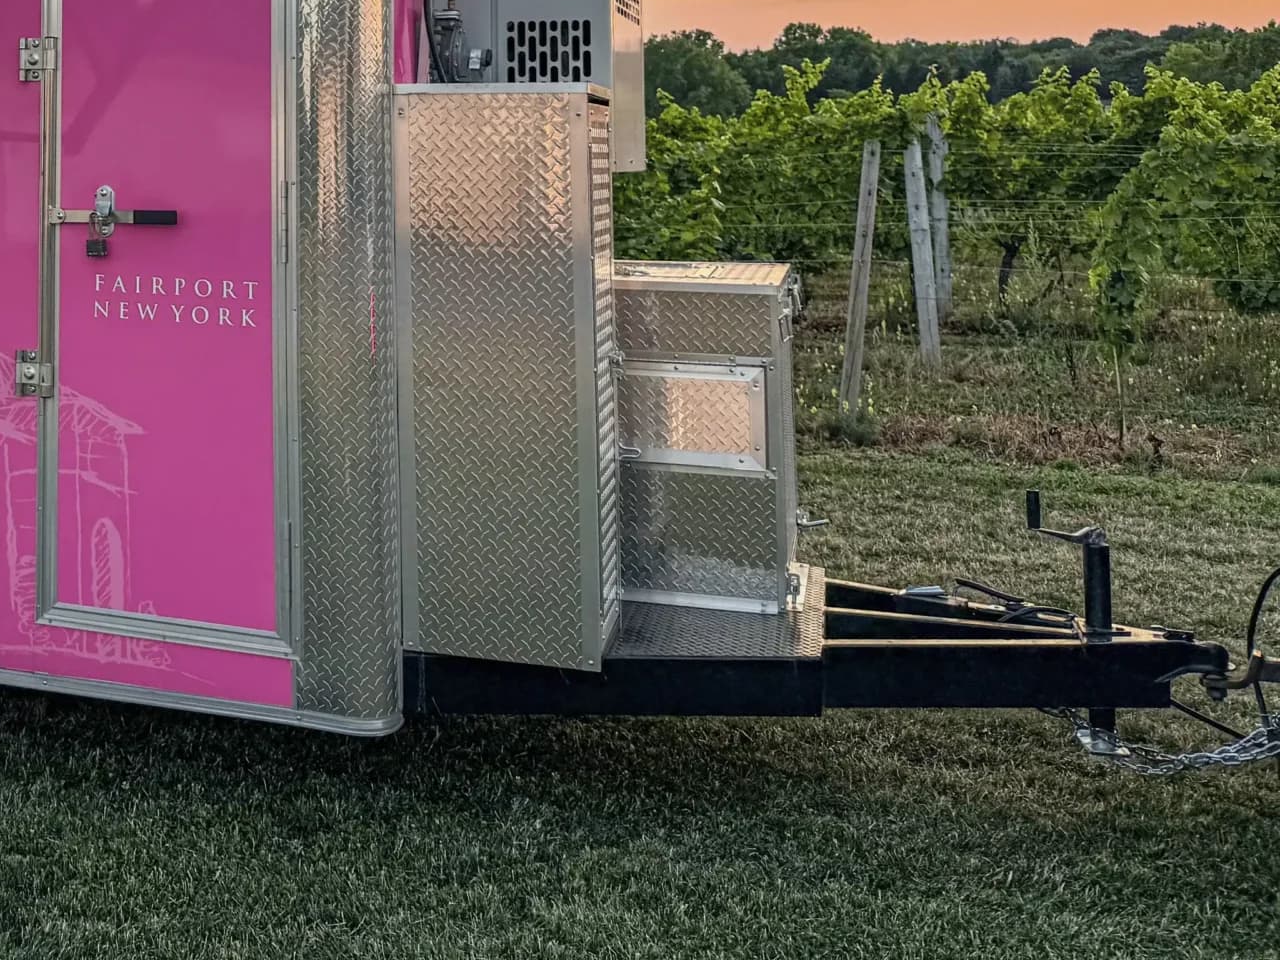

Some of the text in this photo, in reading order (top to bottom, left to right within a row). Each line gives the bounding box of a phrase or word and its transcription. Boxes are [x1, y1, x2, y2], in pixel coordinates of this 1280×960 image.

[95, 274, 259, 300] FAIRPORT
[93, 301, 257, 327] NEW YORK
